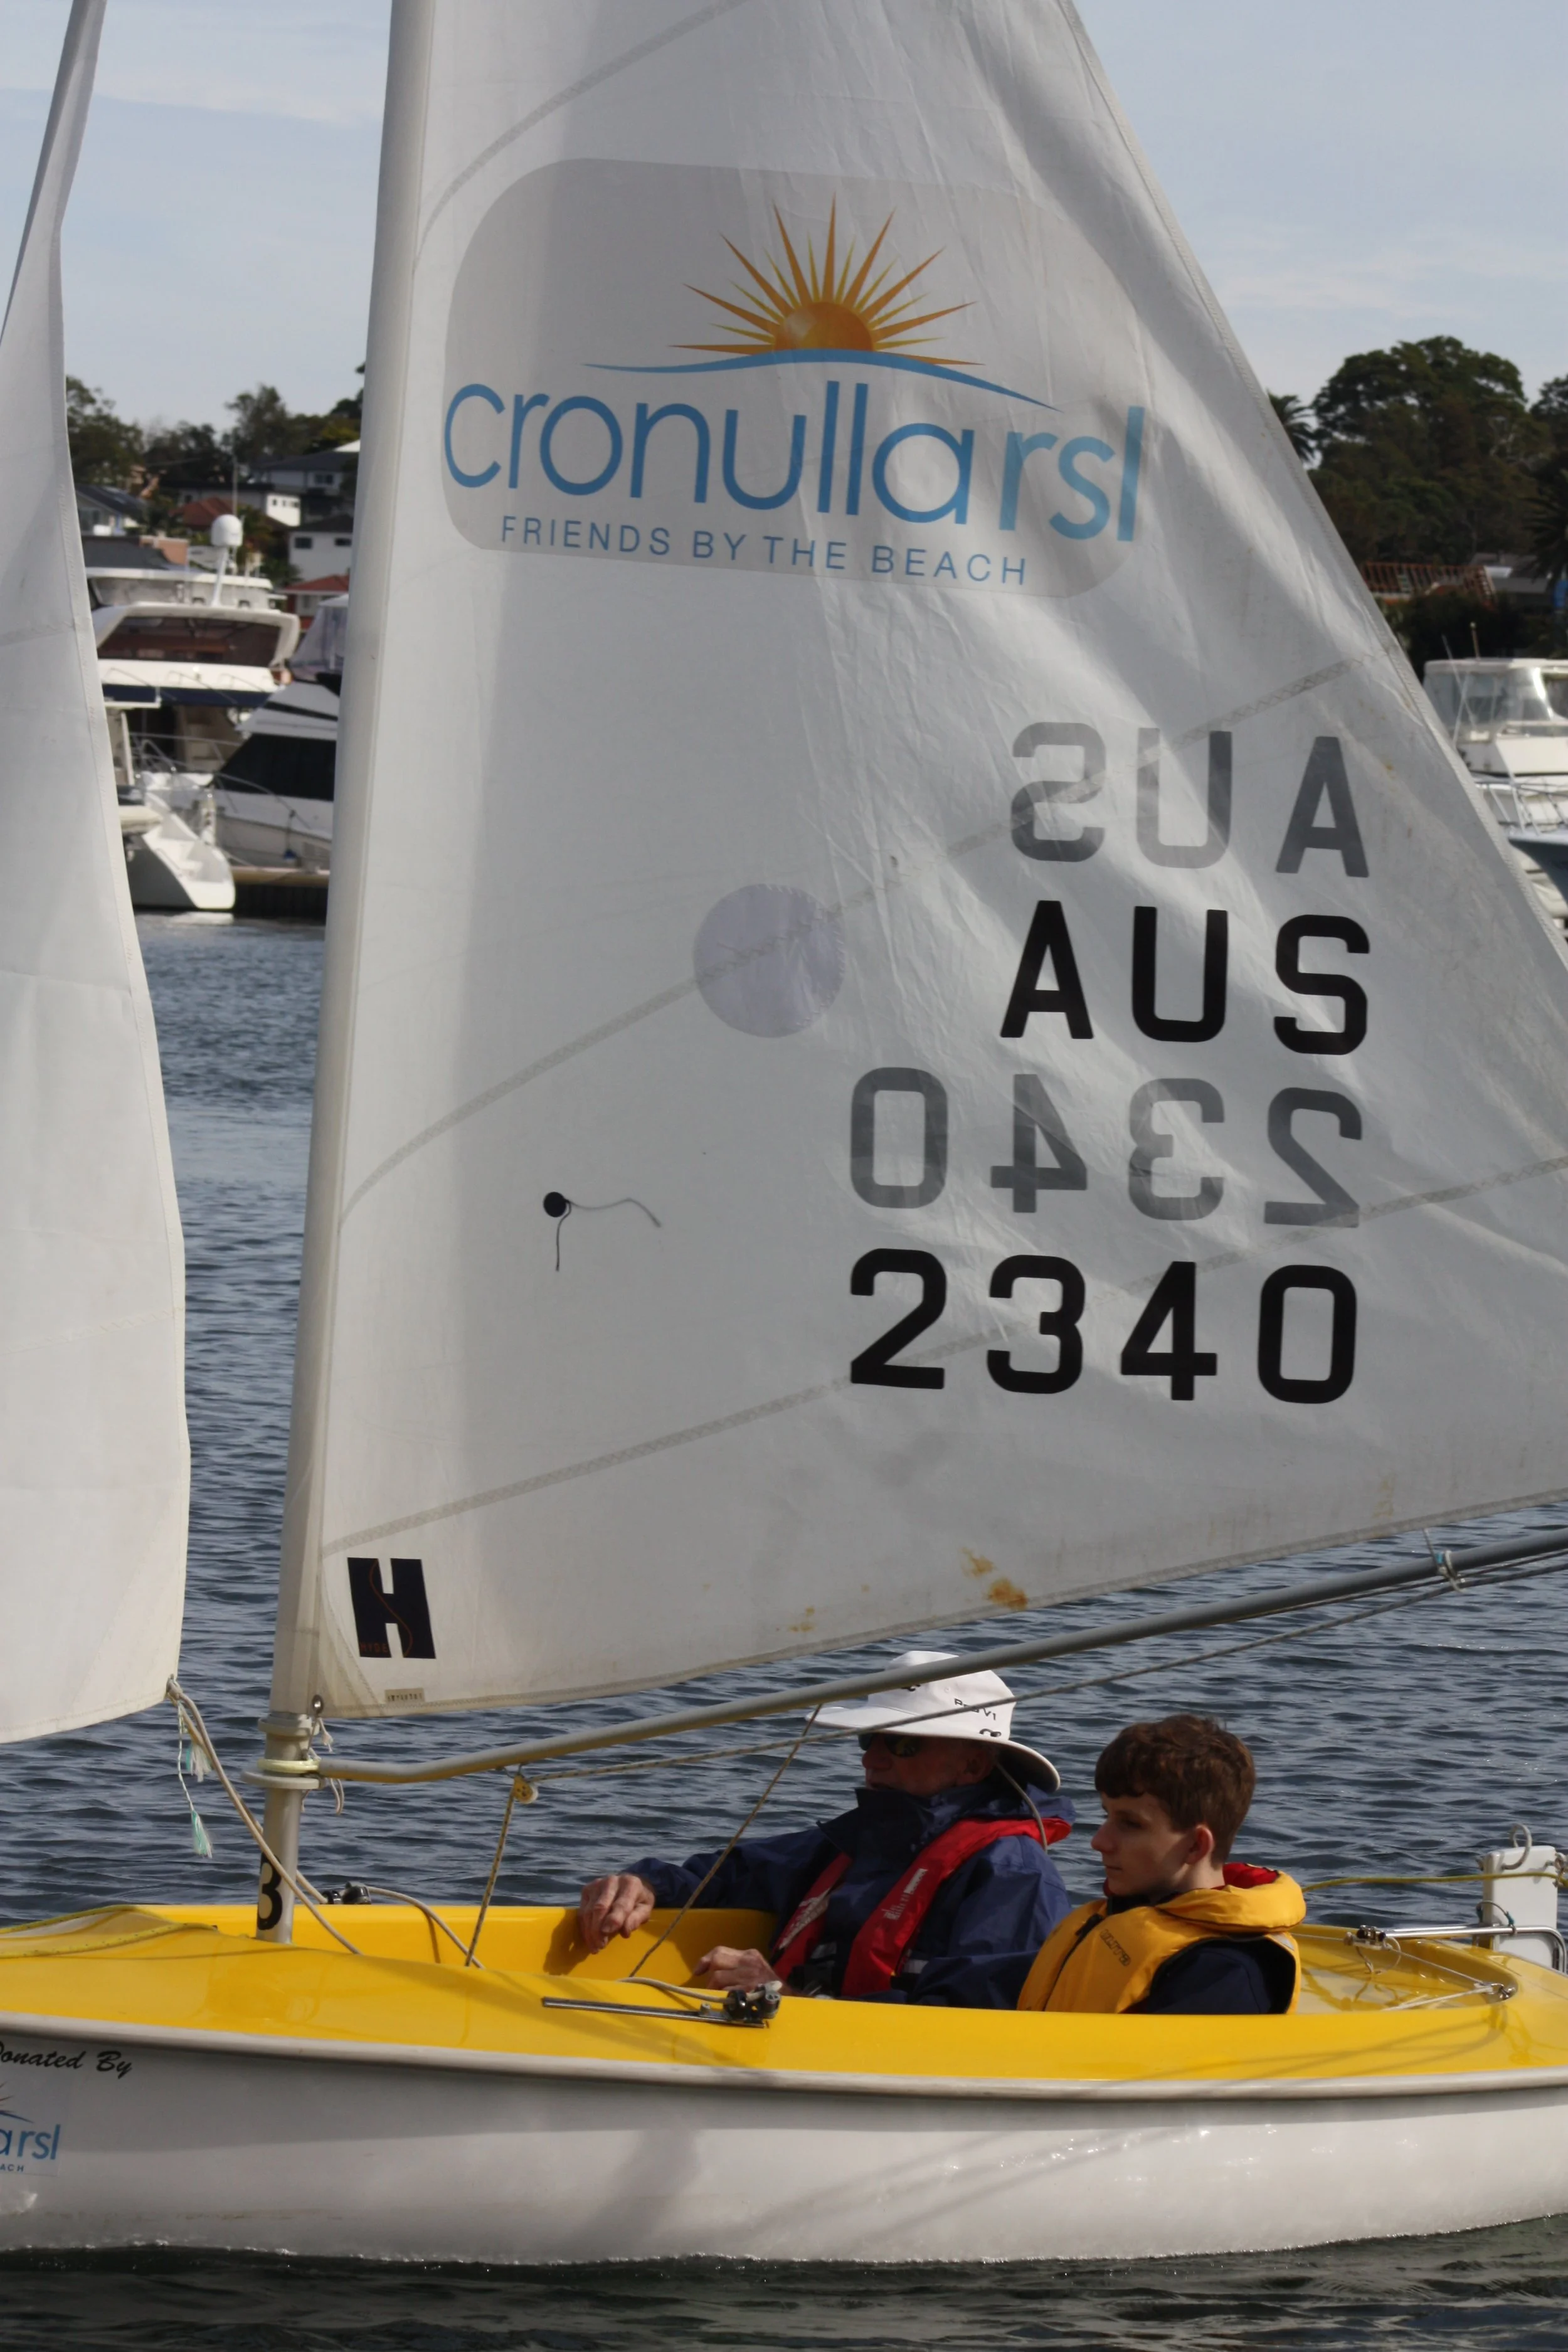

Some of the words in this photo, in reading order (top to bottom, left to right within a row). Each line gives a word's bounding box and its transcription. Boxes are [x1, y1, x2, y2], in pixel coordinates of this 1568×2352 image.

[501, 516, 670, 556] FRIENDS
[692, 531, 746, 559] BY
[763, 536, 845, 570] THE
[871, 546, 1027, 586] BEACH
[999, 899, 1370, 1056] AUS
[849, 1248, 1357, 1404] 2340
[0, 2041, 86, 2069] onated
[95, 2050, 132, 2079] By
